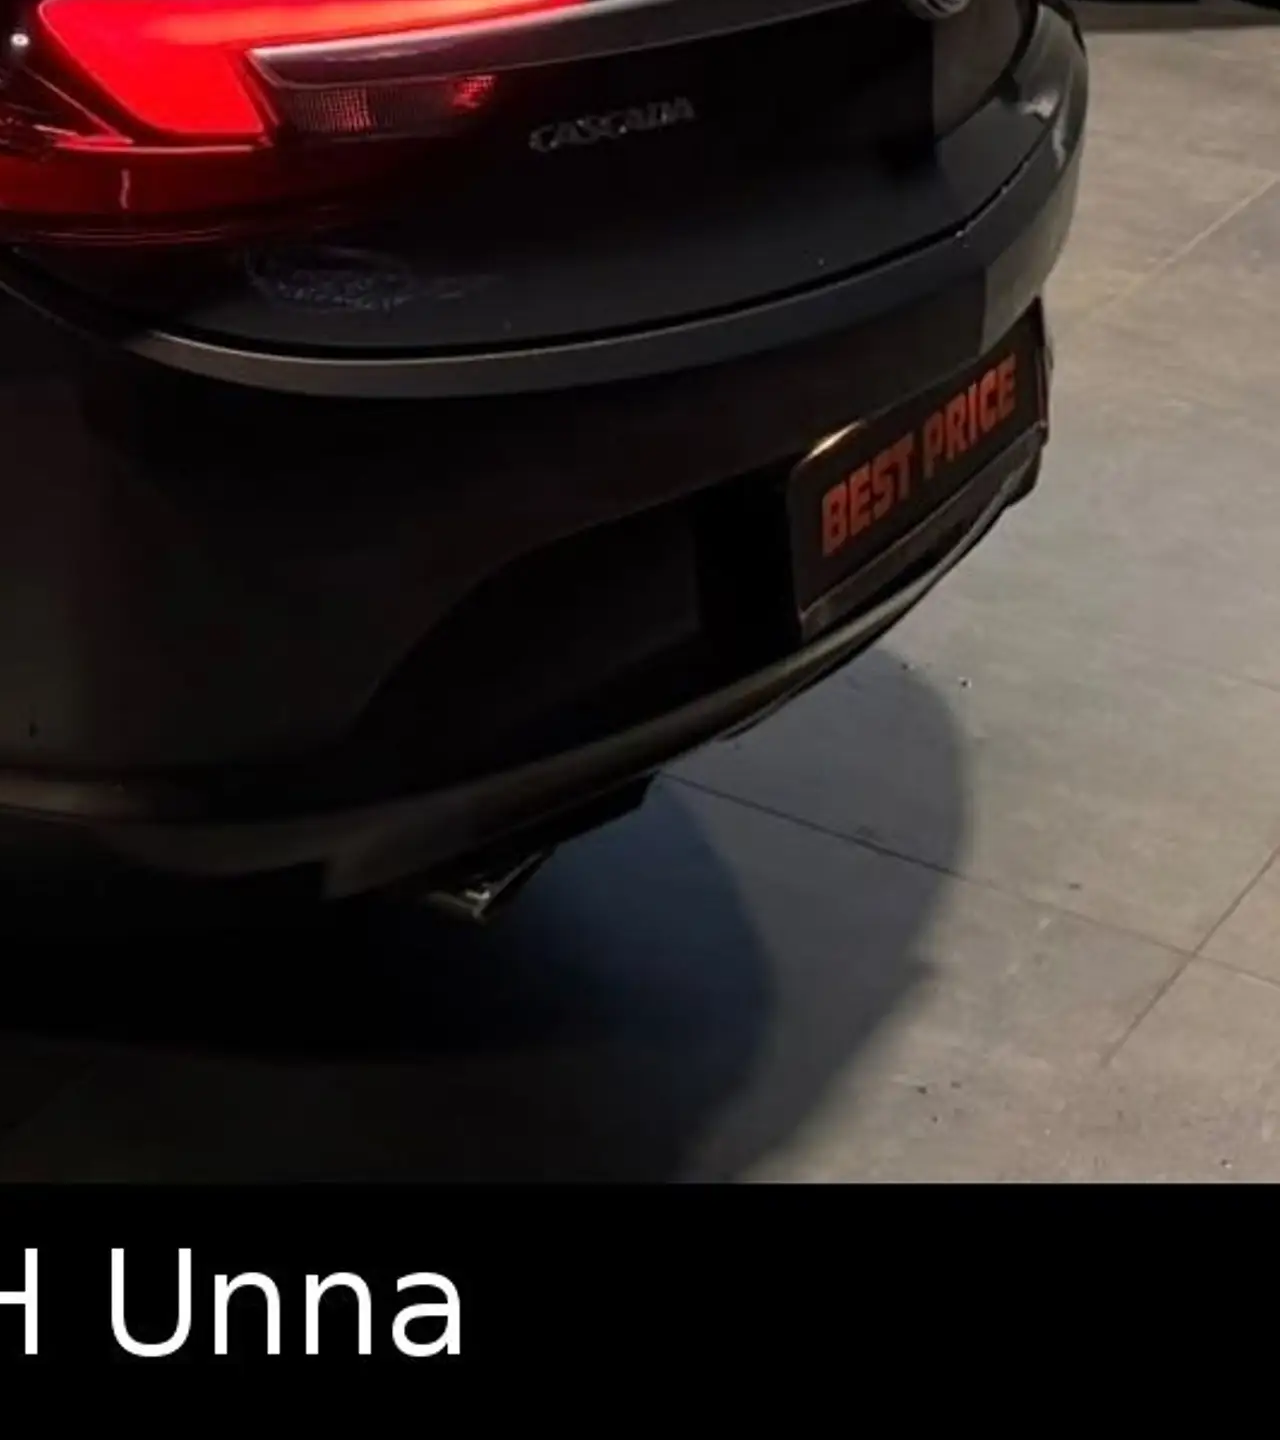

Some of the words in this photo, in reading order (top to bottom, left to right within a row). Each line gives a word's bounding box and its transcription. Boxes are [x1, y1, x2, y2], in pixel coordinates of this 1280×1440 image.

[528, 96, 695, 152] CASCADA
[821, 431, 914, 558] BEST
[923, 352, 1017, 480] PRICE
